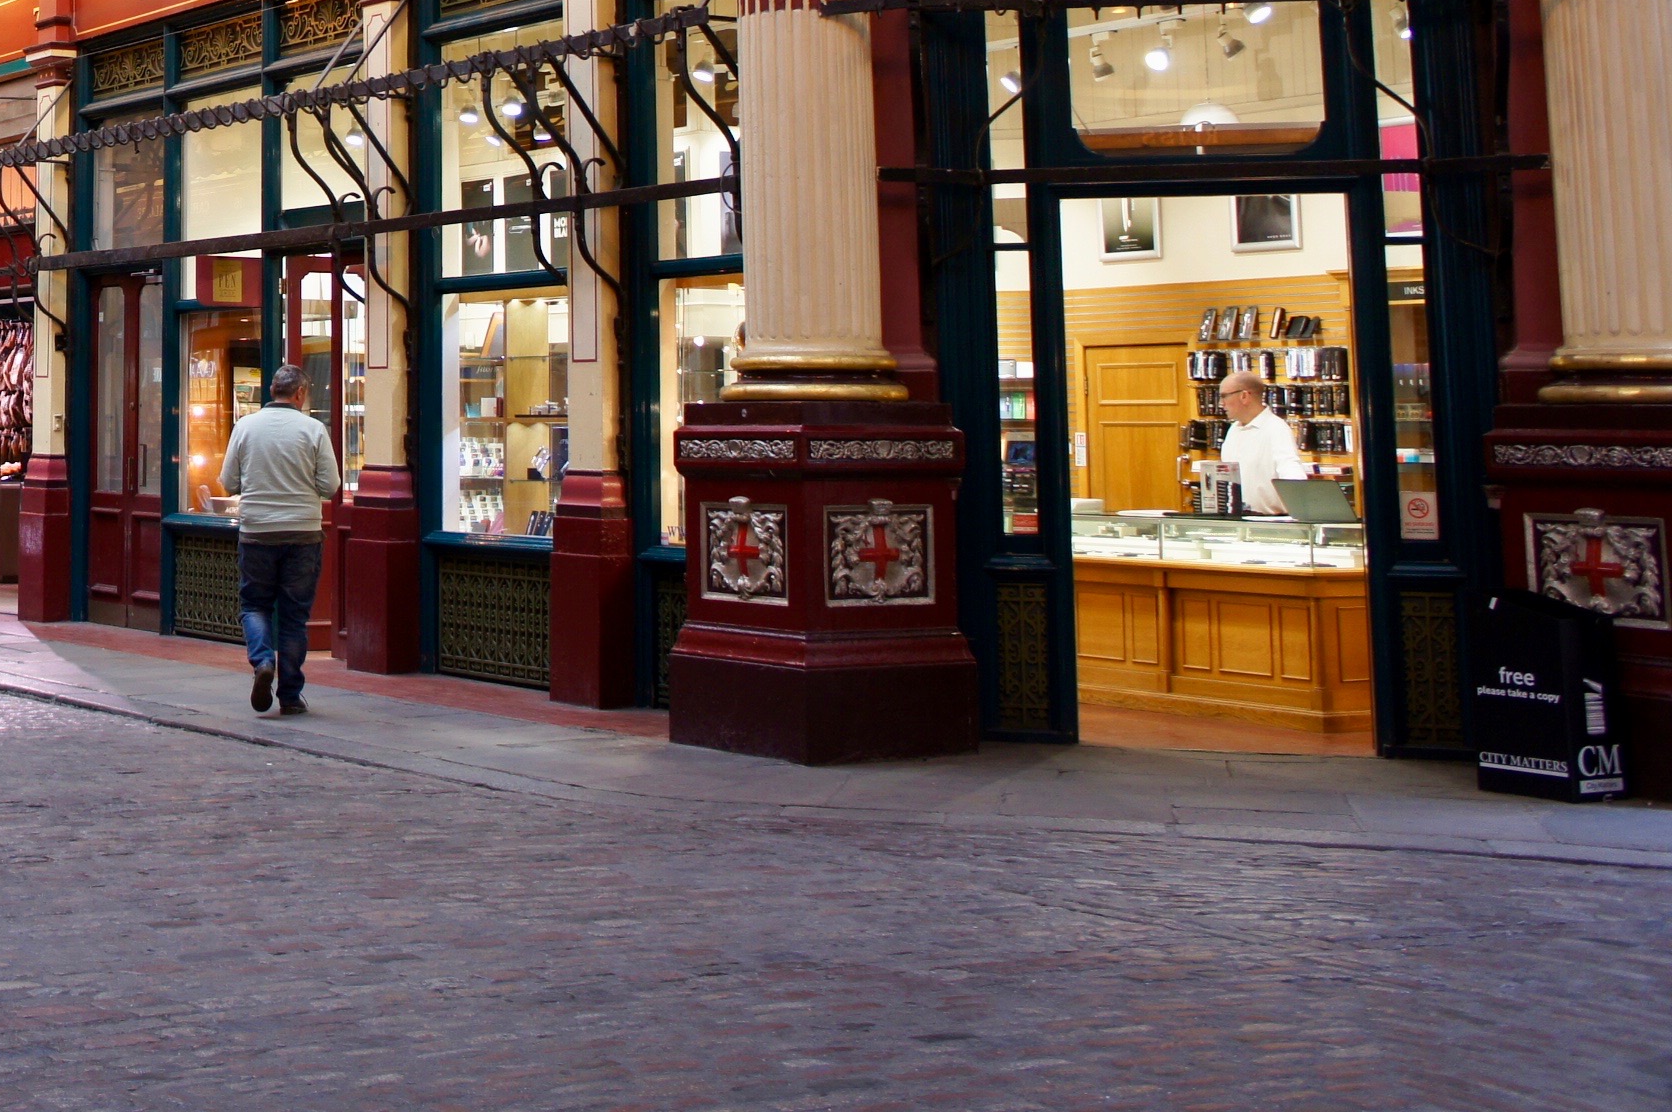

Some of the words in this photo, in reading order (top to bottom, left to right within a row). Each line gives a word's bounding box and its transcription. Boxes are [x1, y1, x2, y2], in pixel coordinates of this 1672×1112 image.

[553, 217, 567, 228] MO
[553, 228, 567, 239] BLA
[218, 273, 236, 290] PEN
[1404, 286, 1425, 296] INKS
[1498, 666, 1535, 687] free
[1476, 685, 1506, 698] please
[1507, 687, 1528, 699] take
[1528, 692, 1536, 700] a
[1536, 691, 1560, 704] copy
[1479, 751, 1509, 765] CITY
[1509, 756, 1568, 772] MATTERS
[1577, 744, 1622, 777] CM
